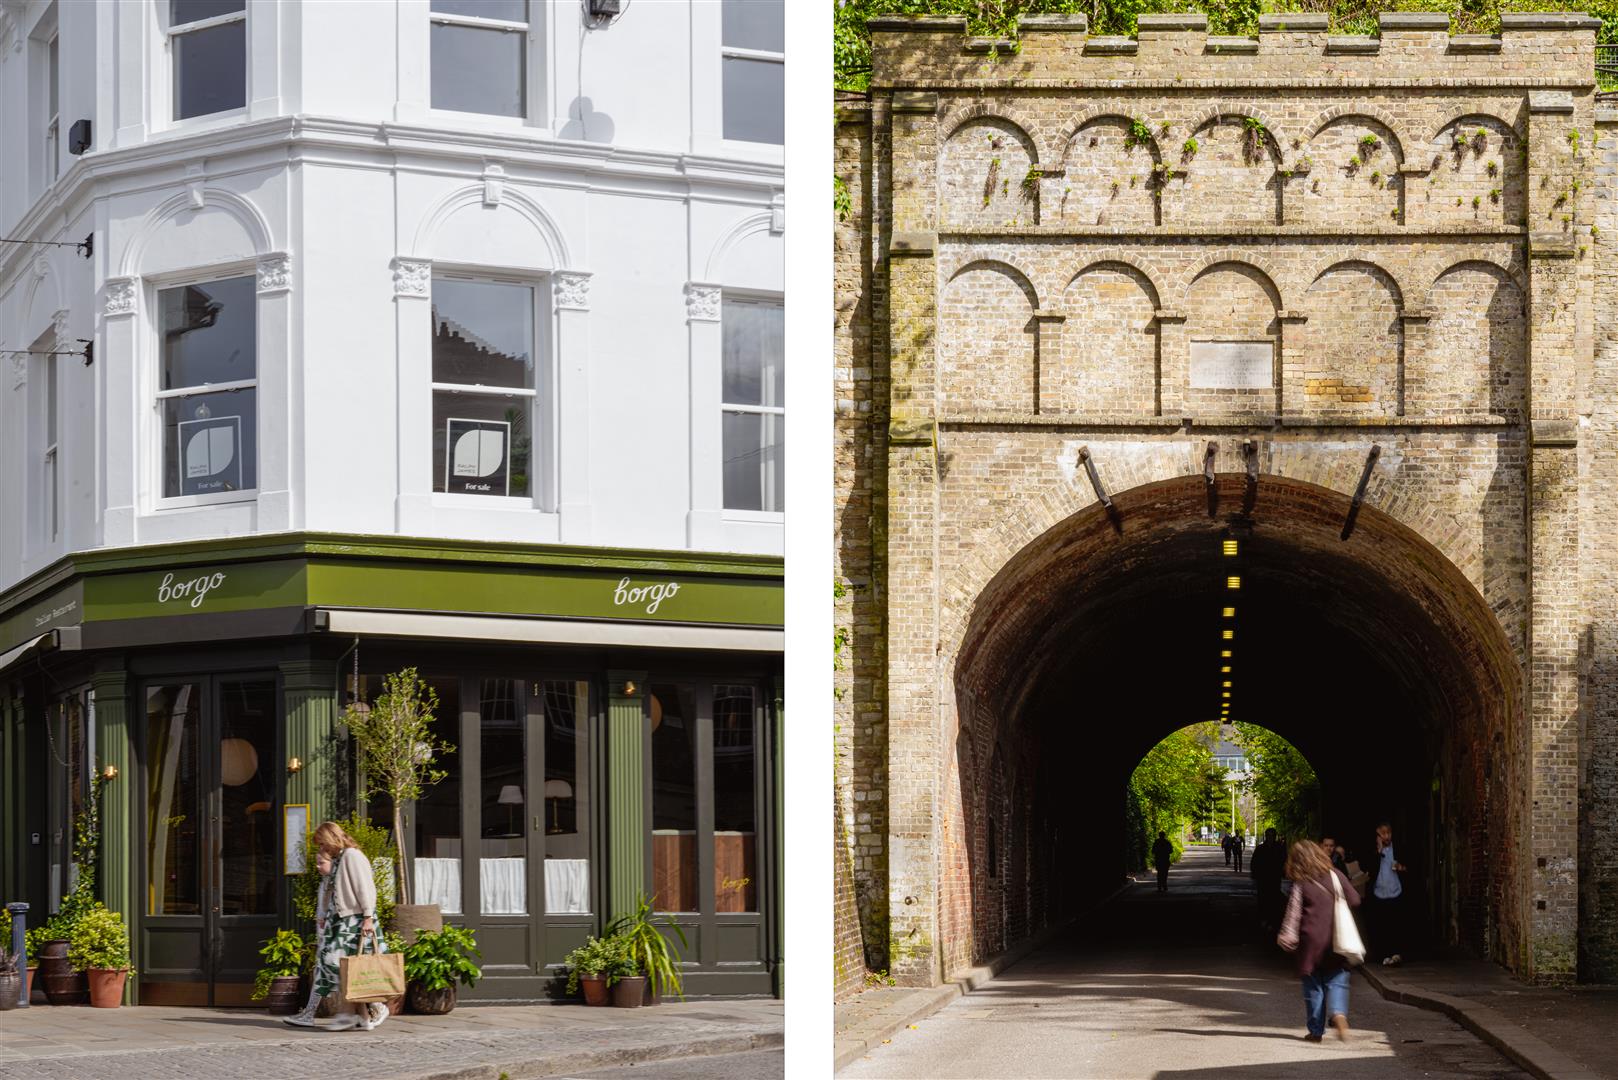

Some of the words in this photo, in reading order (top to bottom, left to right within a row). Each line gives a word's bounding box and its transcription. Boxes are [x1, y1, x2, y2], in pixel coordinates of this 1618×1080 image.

[158, 572, 226, 608] borgo
[614, 577, 681, 614] borgo
[722, 876, 750, 893] borgo
